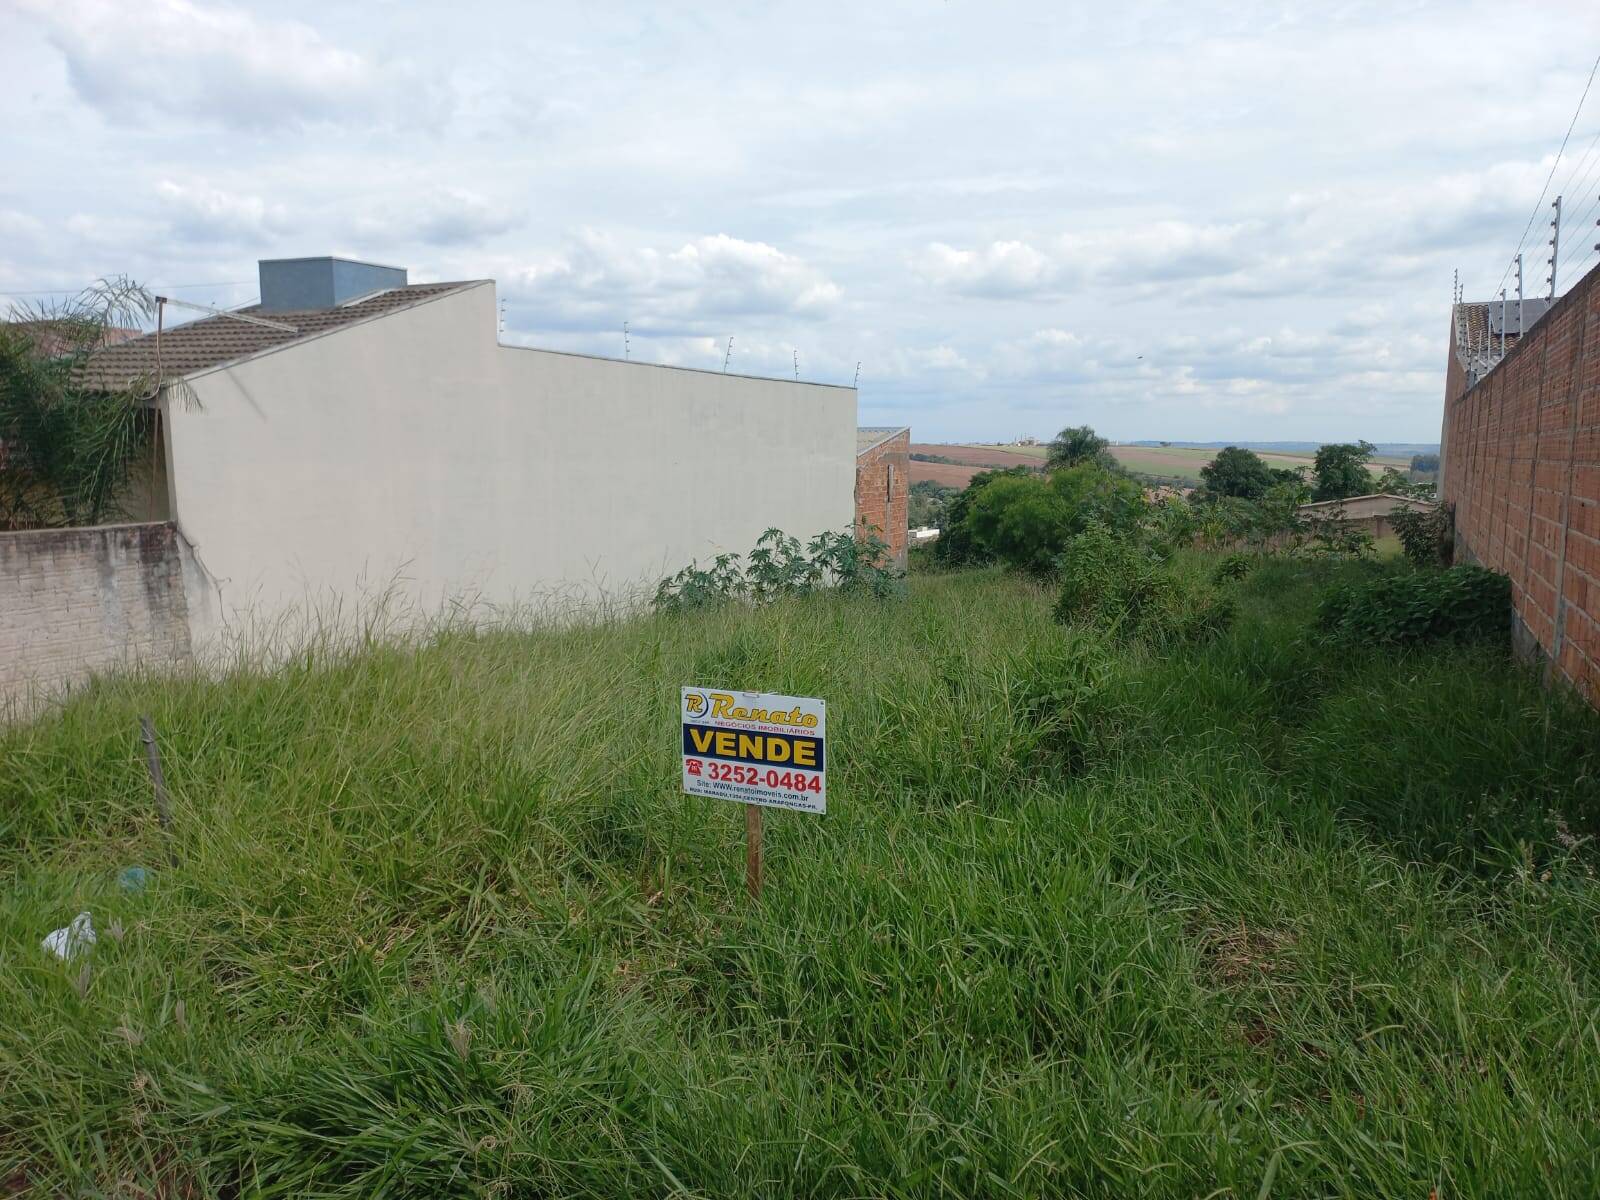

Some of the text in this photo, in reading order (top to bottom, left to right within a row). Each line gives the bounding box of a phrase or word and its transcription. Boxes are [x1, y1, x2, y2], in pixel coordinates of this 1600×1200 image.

[709, 693, 818, 728] Renato
[714, 720, 757, 730] NEGÓCIOS
[758, 725, 815, 736] IMOBILIÁRIOS
[689, 728, 816, 767] VENDE
[696, 779, 711, 788] Site:
[707, 762, 822, 794] 3252-0484
